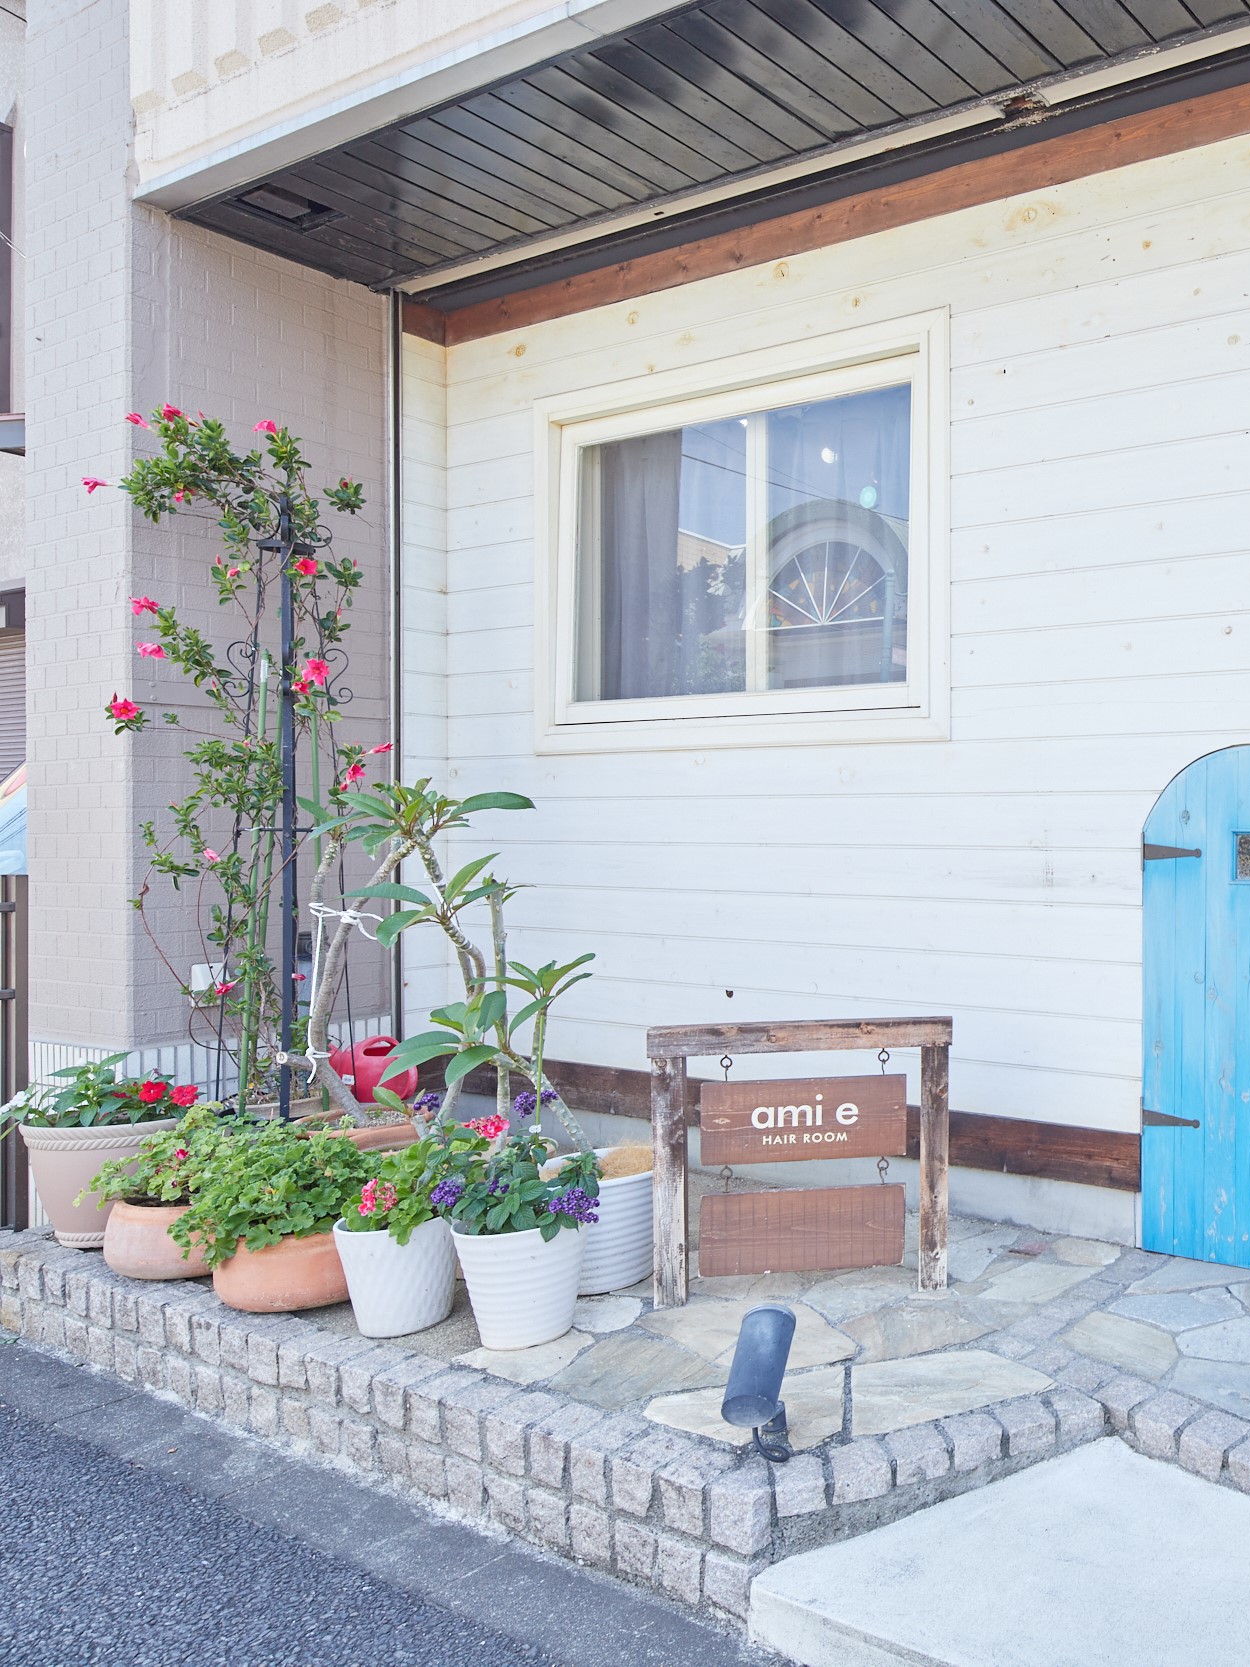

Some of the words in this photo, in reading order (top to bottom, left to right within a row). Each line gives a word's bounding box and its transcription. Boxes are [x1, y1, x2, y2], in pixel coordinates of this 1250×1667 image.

[751, 1093, 823, 1129] ami
[835, 1102, 859, 1125] e
[762, 1133, 797, 1146] HAIR
[803, 1131, 848, 1144] ROOM
